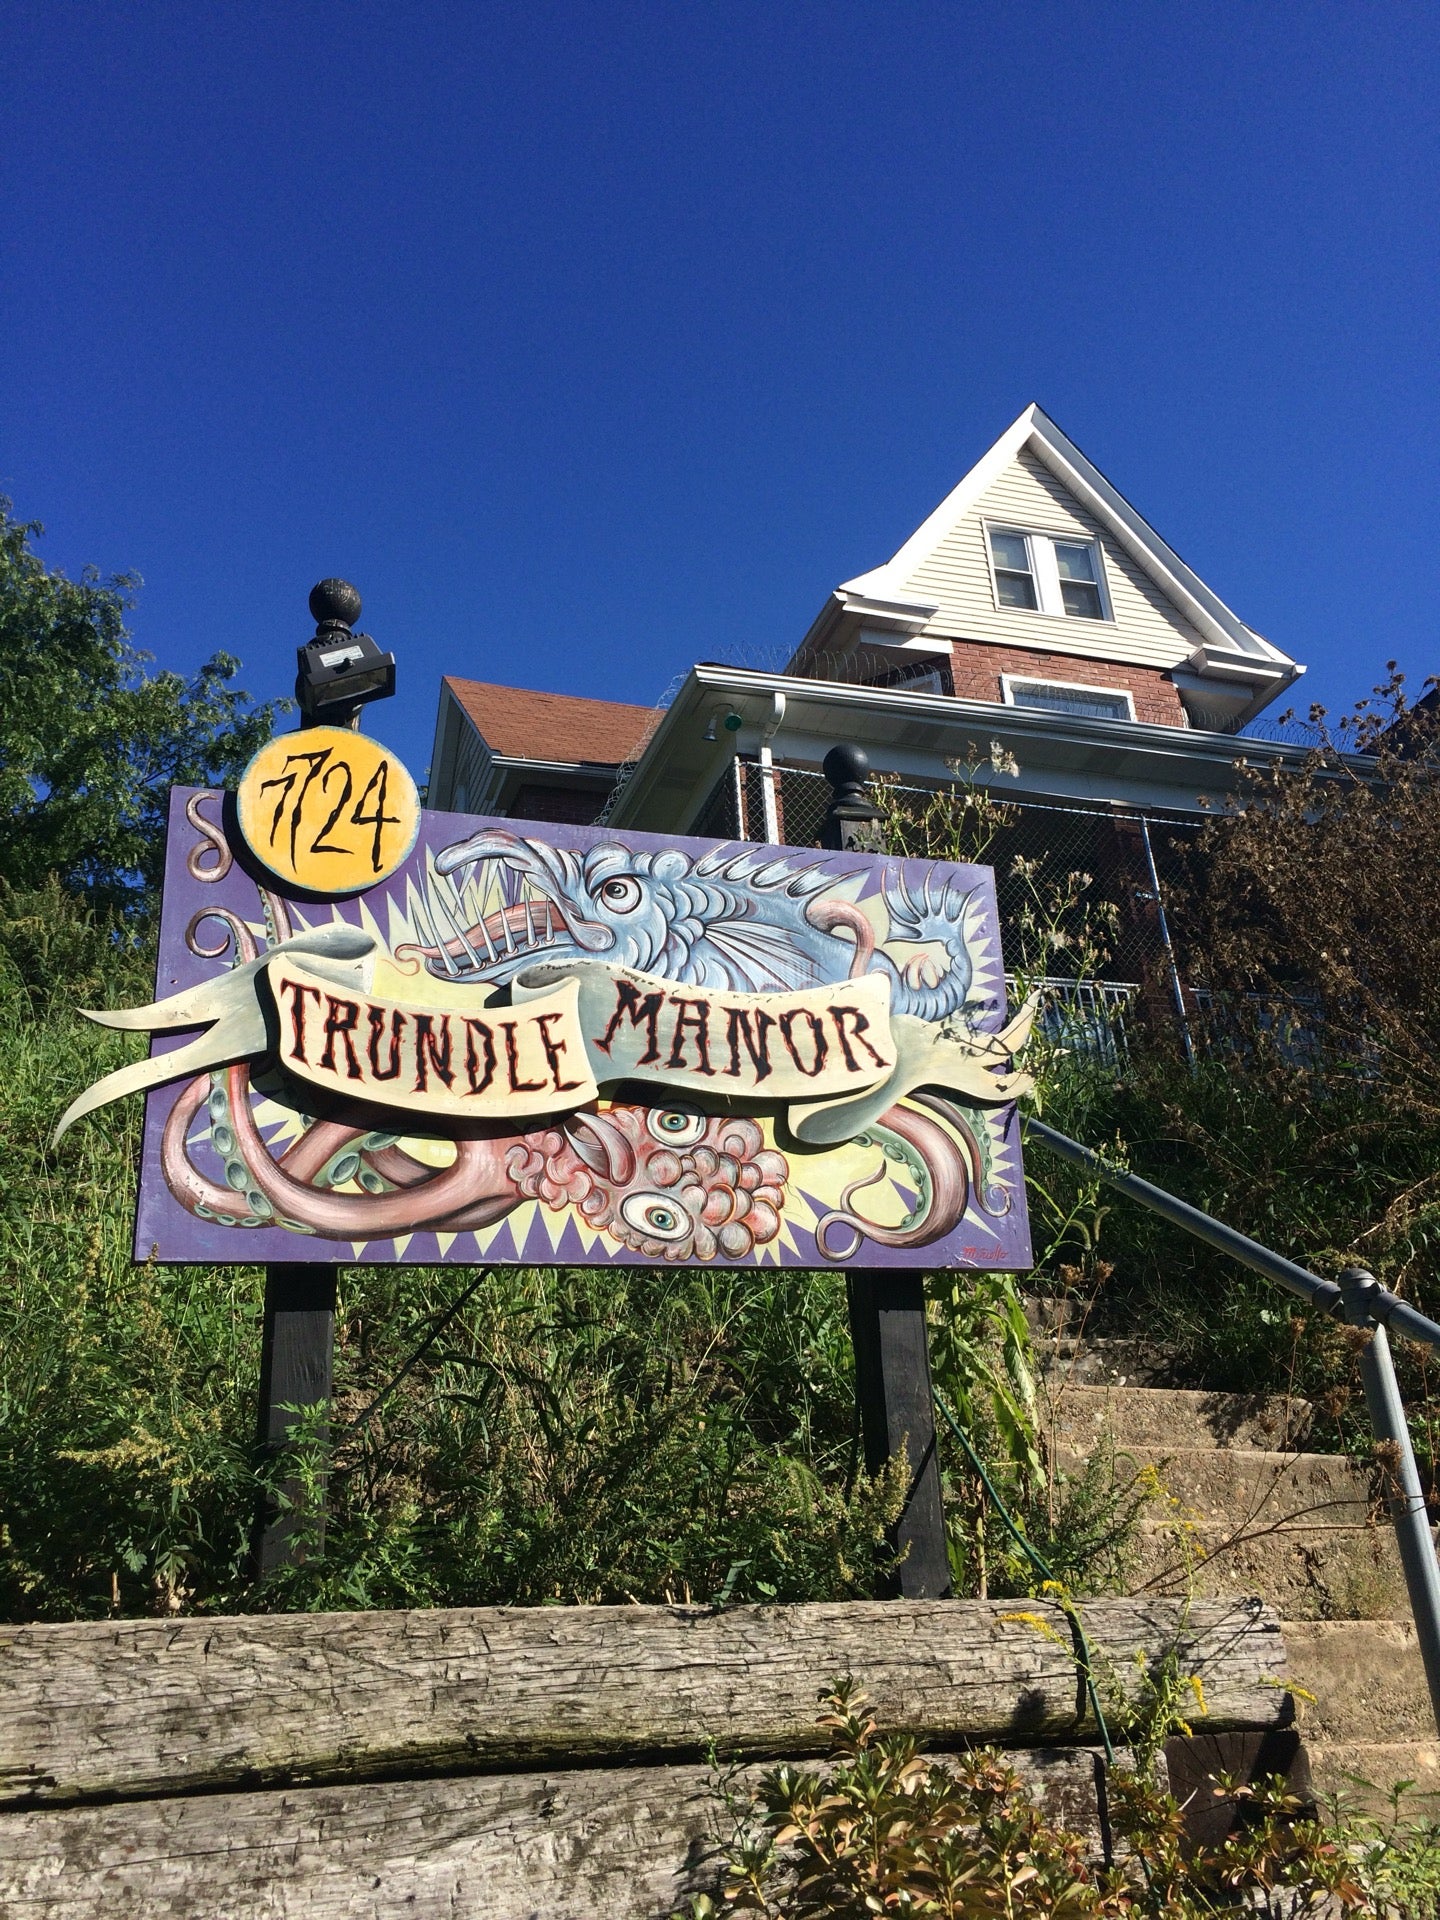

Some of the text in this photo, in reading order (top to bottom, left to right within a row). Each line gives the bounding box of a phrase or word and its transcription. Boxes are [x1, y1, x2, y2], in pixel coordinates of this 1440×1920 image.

[260, 747, 401, 873] 7724
[280, 977, 891, 1099] TRUNDLE MANOR
